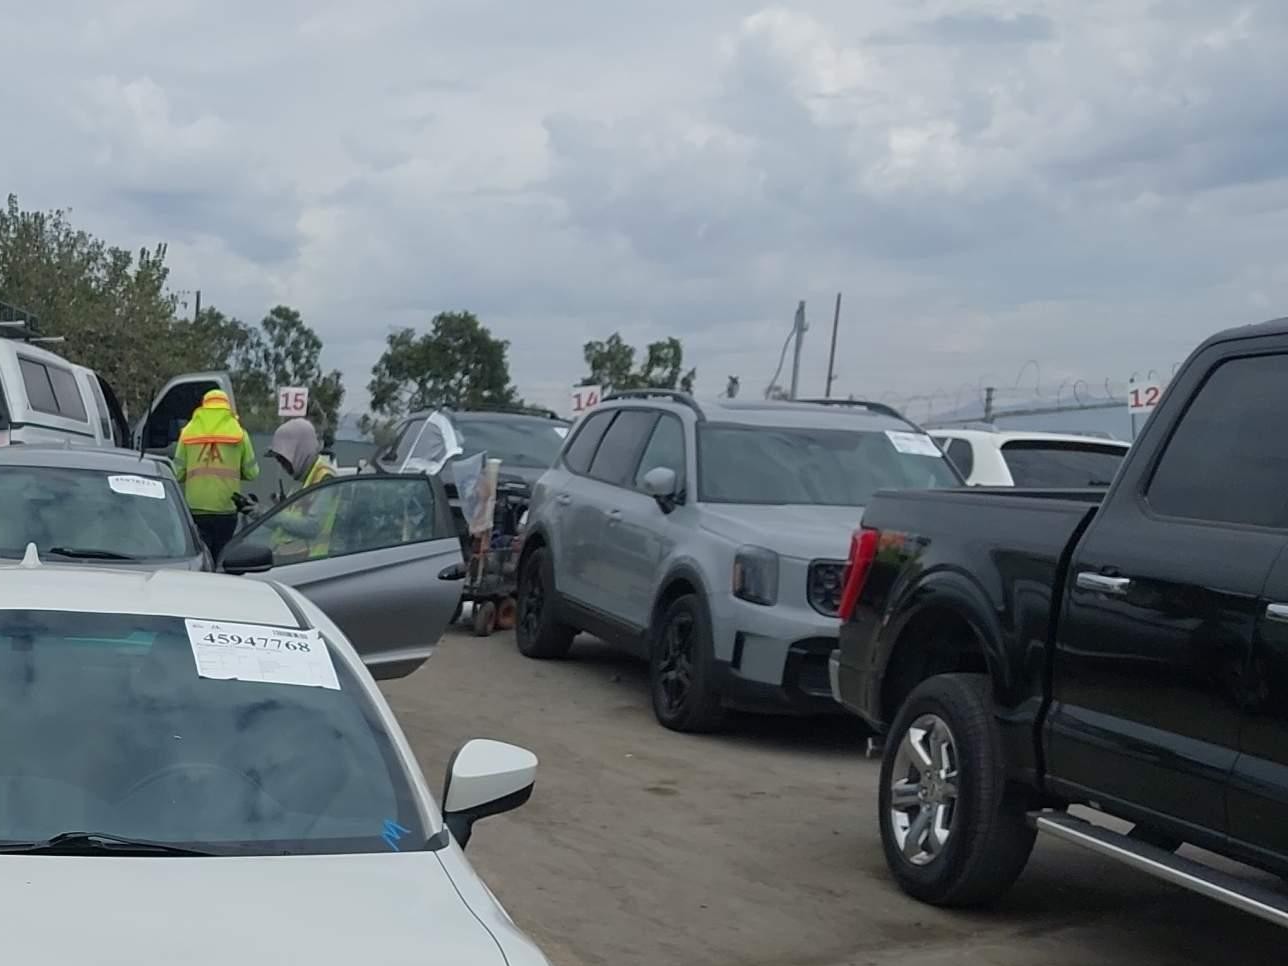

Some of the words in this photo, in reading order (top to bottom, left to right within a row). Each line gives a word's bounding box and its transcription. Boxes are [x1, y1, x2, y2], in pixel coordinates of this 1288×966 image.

[280, 392, 305, 410] 15
[1129, 386, 1160, 408] 12
[203, 632, 312, 653] 45947768
